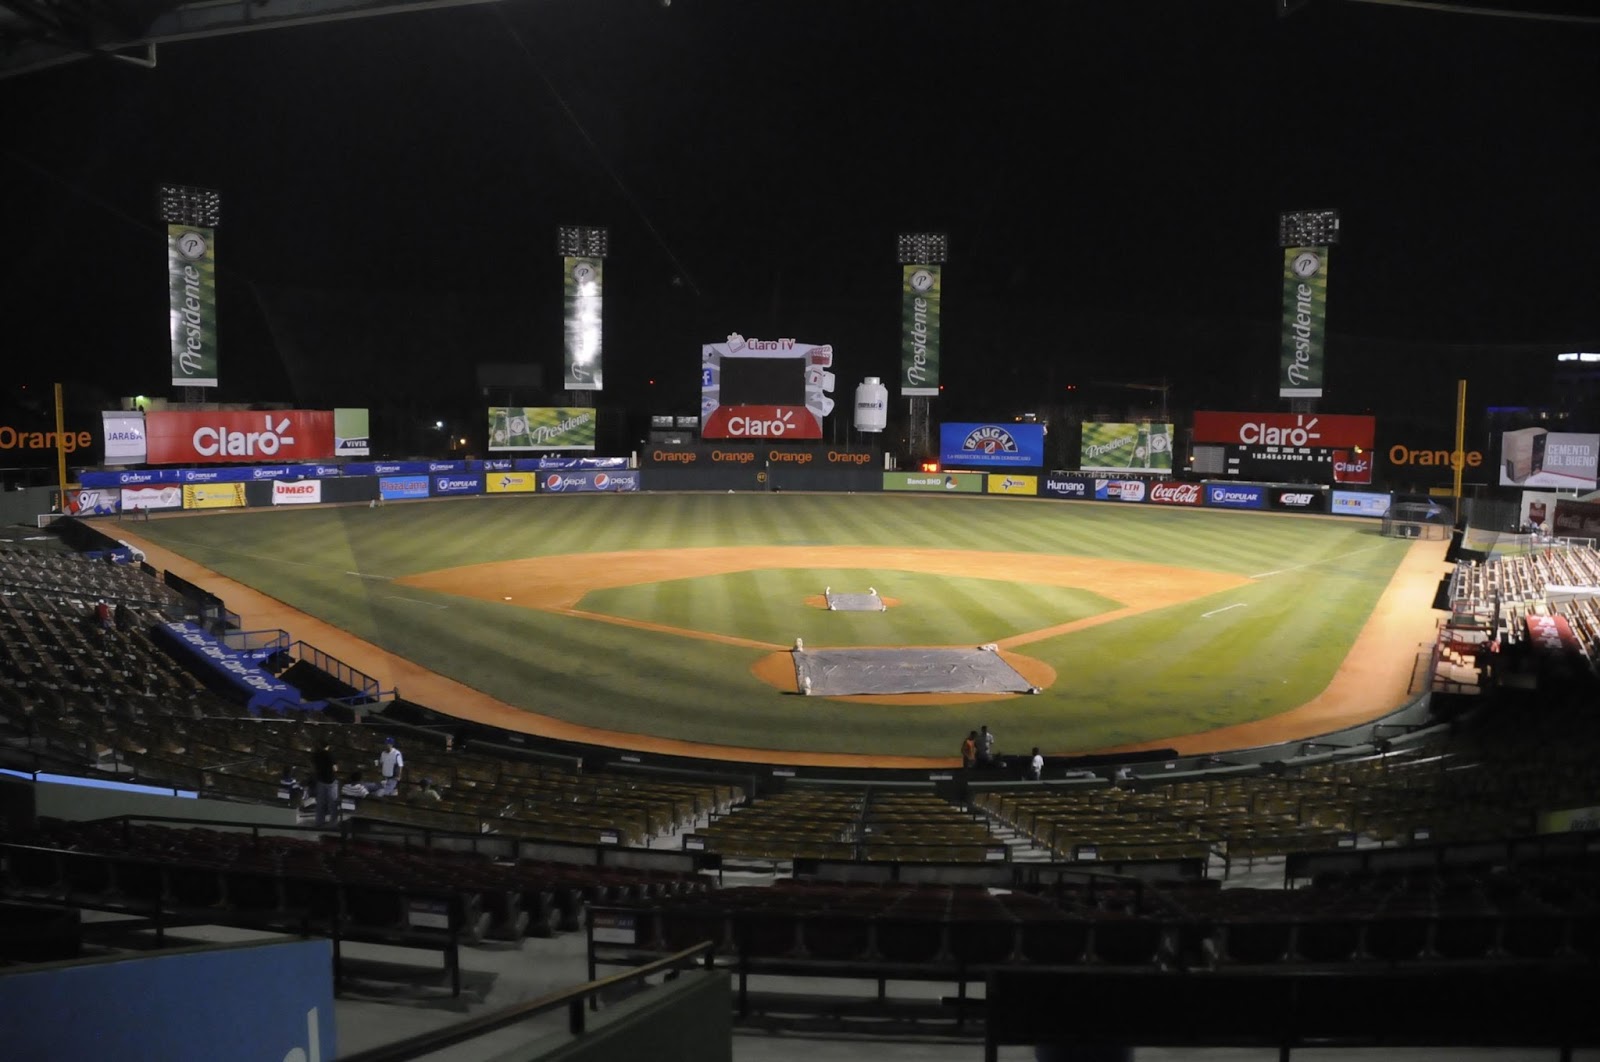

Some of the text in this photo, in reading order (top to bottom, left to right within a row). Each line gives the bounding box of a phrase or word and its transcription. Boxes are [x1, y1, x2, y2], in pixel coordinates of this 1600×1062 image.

[179, 265, 204, 375] Presidente
[1287, 283, 1312, 386] Presidente
[748, 338, 796, 351] Claro TV
[907, 297, 928, 386] Presidente
[531, 412, 590, 444] Presidente
[728, 417, 785, 436] Claro
[965, 427, 1014, 451] BRUGAL
[1239, 422, 1308, 446] Claro
[193, 426, 280, 456] Claro
[346, 441, 367, 450] VIVIR
[653, 450, 696, 463] Orange
[711, 450, 754, 463] Orange
[1548, 444, 1590, 456] CEMENTO
[769, 450, 812, 464] Orange
[827, 451, 871, 465] Orange
[1389, 444, 1483, 470] Orange
[1547, 455, 1595, 466] DEL BUENO
[1334, 461, 1363, 473] Claro
[449, 480, 477, 488] POPULAR
[563, 477, 586, 487] pepsi
[610, 476, 635, 487] pepsi
[1047, 480, 1085, 491] Humano
[276, 485, 314, 495] UMBO
[1150, 483, 1201, 502] Coca-Cola
[79, 492, 100, 513] 911
[1225, 493, 1258, 501] POPULAR
